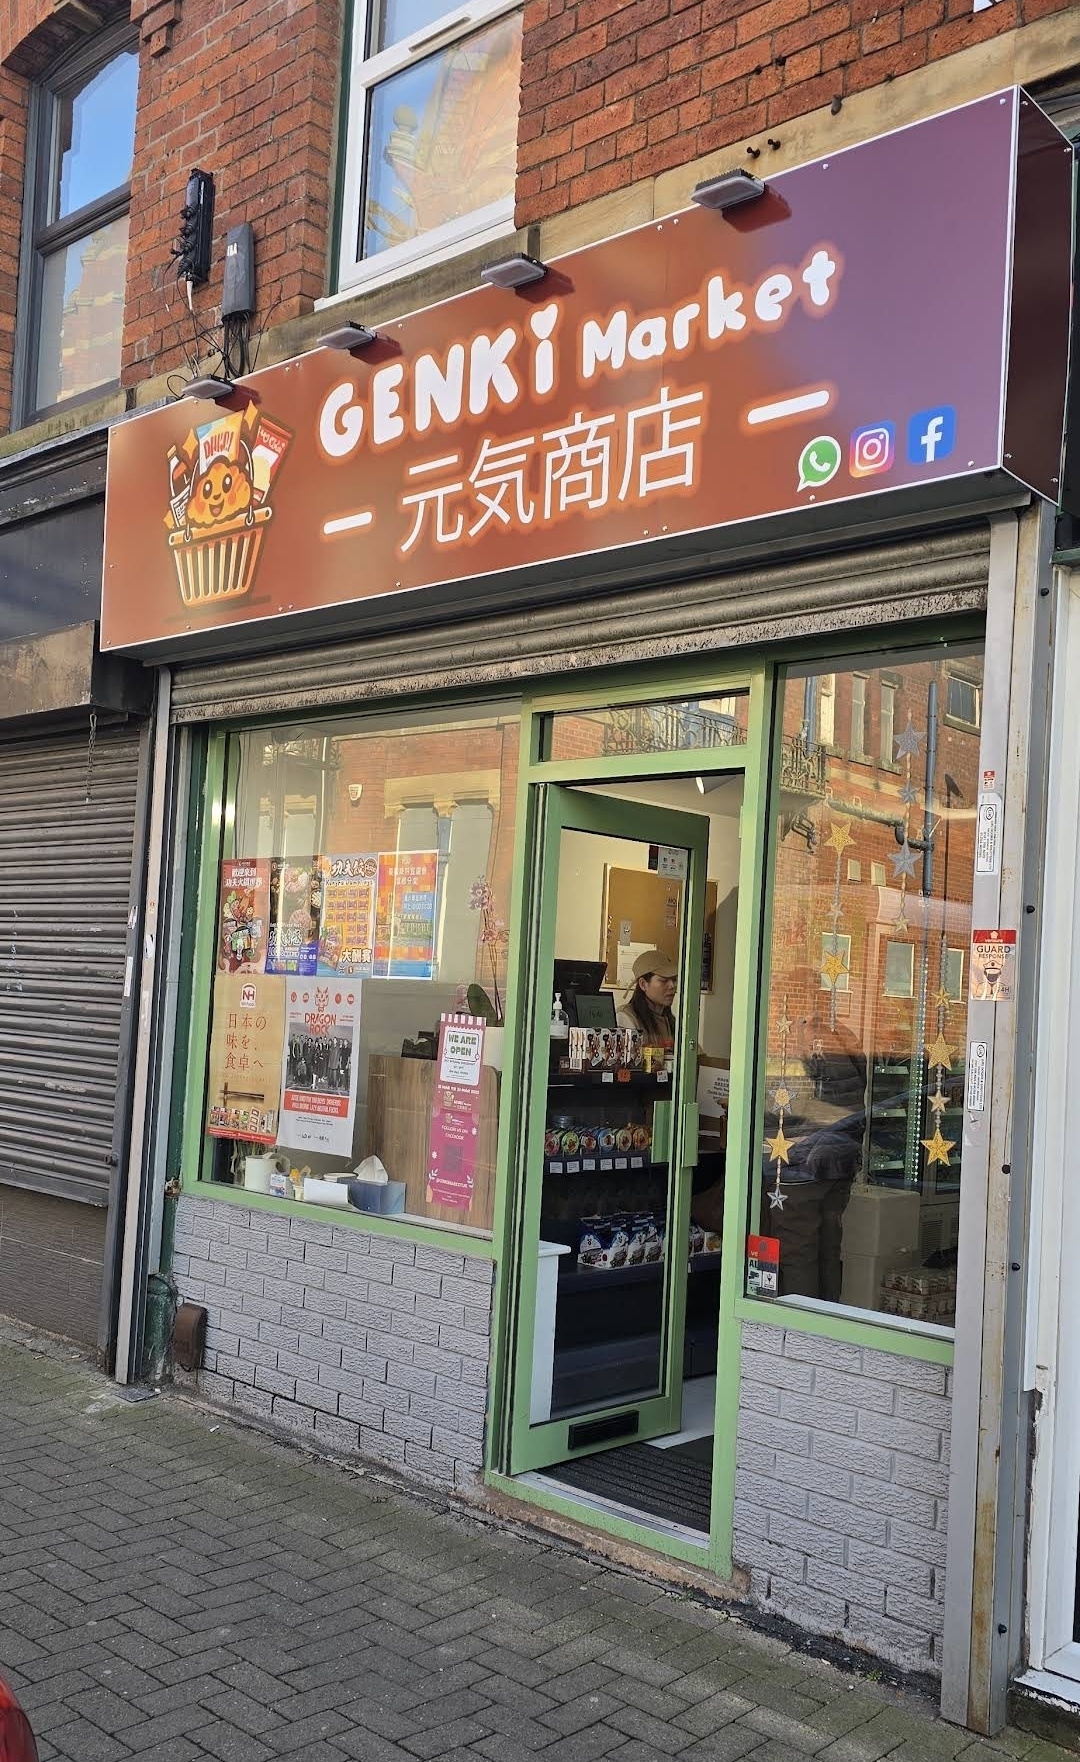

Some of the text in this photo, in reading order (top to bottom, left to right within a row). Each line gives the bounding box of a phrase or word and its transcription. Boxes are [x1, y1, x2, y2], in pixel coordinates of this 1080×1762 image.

[583, 250, 836, 378] Market
[400, 386, 703, 553] 元気商店
[976, 945, 1011, 954] GUARD
[228, 1013, 267, 1031] 日本の
[304, 1012, 337, 1026] DRAGON
[309, 1024, 330, 1036] ROCK
[448, 1034, 477, 1046] WE ARE
[450, 1045, 472, 1056] OPEN
[225, 1052, 264, 1071] 食卓へ
